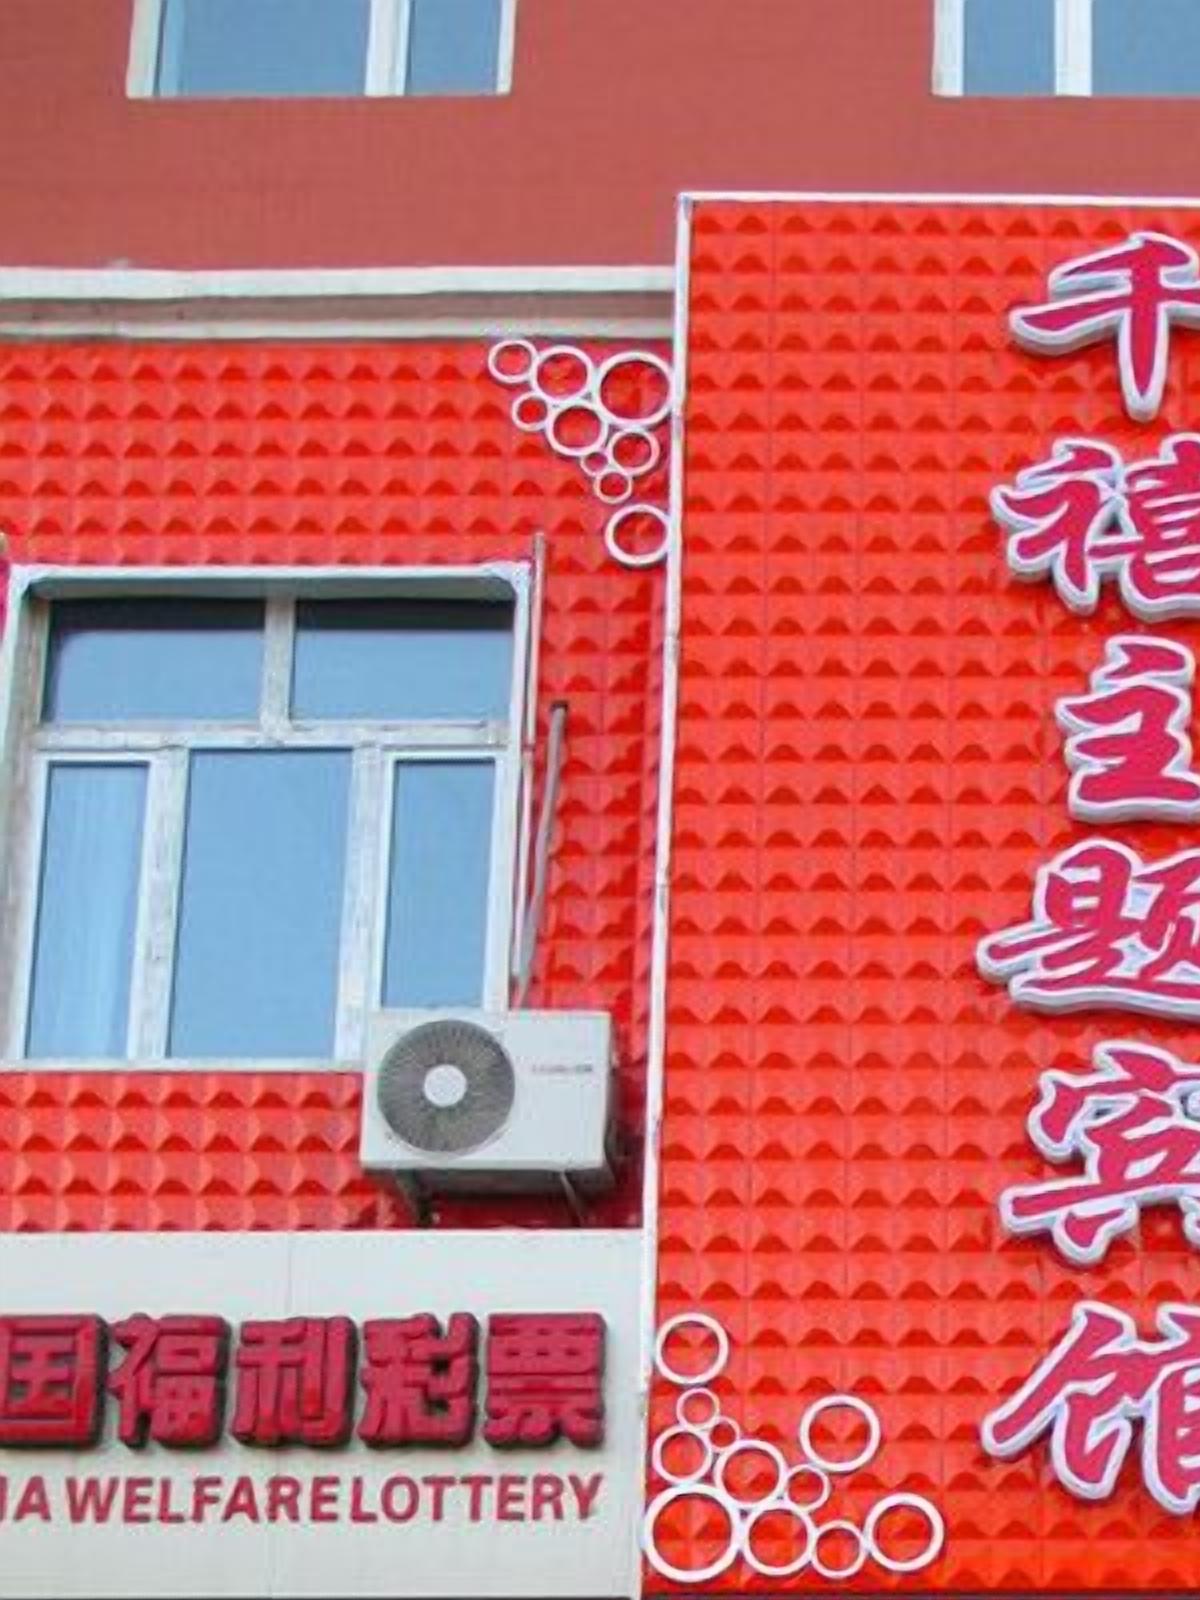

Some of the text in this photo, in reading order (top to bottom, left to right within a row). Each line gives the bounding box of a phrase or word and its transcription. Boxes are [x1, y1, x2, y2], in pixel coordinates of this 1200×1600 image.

[0, 1312, 607, 1448] 国福利彩票
[66, 1474, 339, 1523] WELFARE
[350, 1473, 604, 1521] LOTTERY
